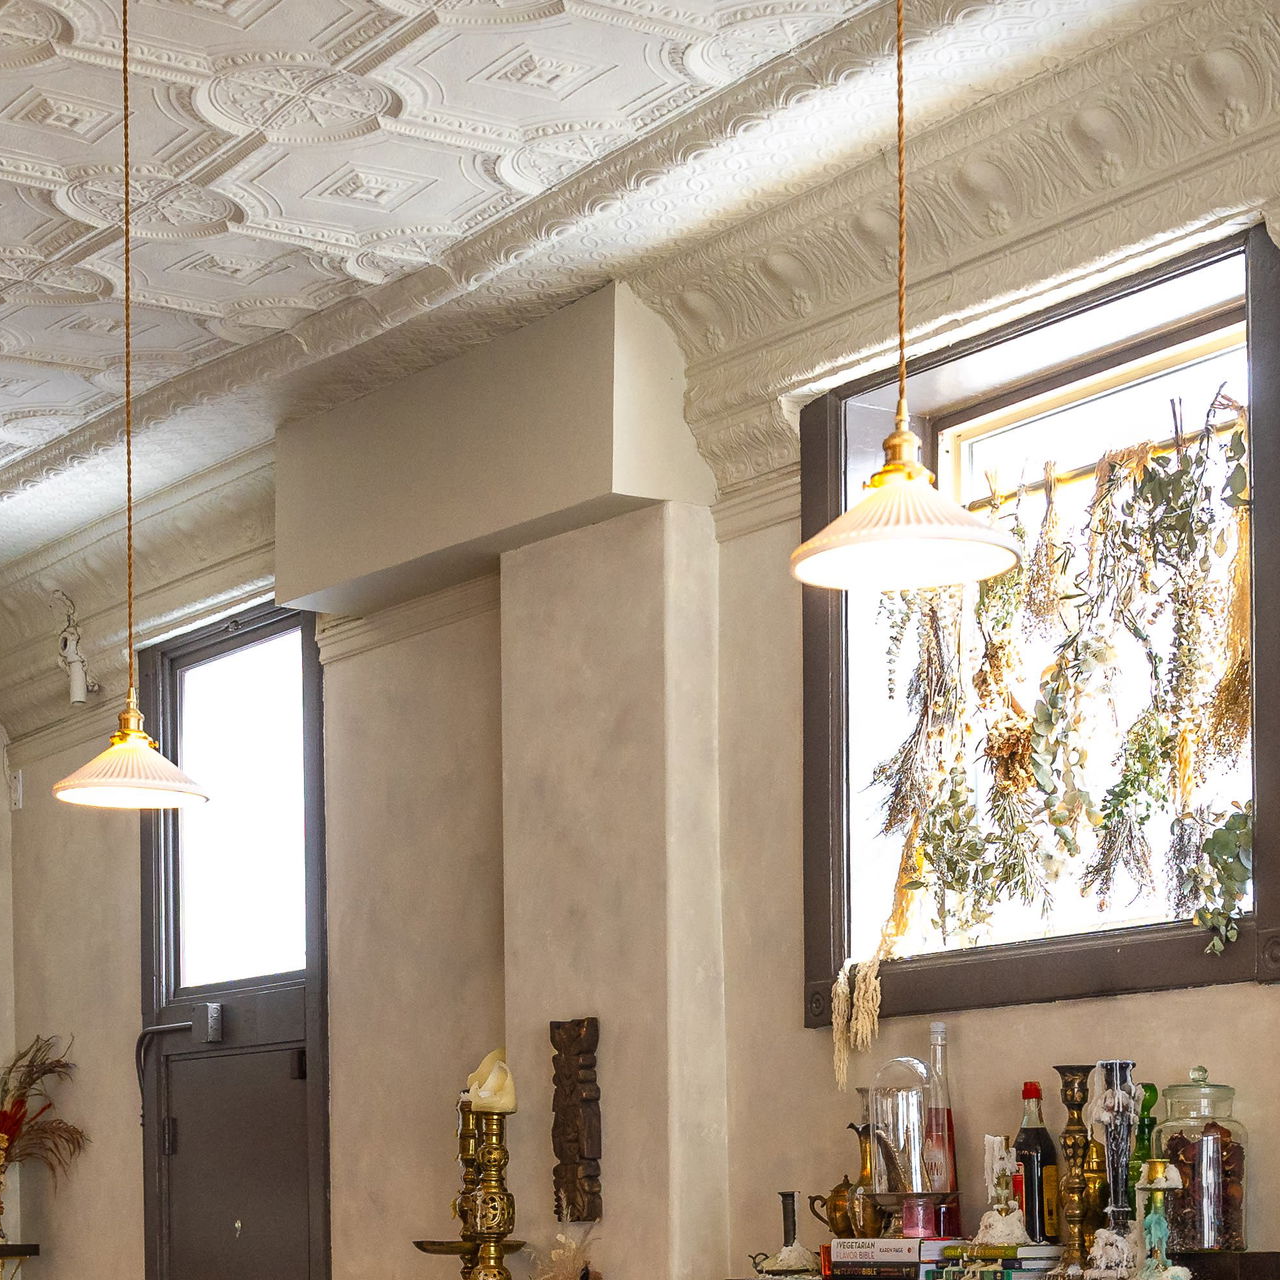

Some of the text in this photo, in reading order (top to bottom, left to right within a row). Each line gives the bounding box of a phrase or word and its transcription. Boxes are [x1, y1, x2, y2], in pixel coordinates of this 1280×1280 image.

[839, 1241, 876, 1249] VEGETARIAN
[836, 1251, 875, 1260] FLAVOR BIBLE
